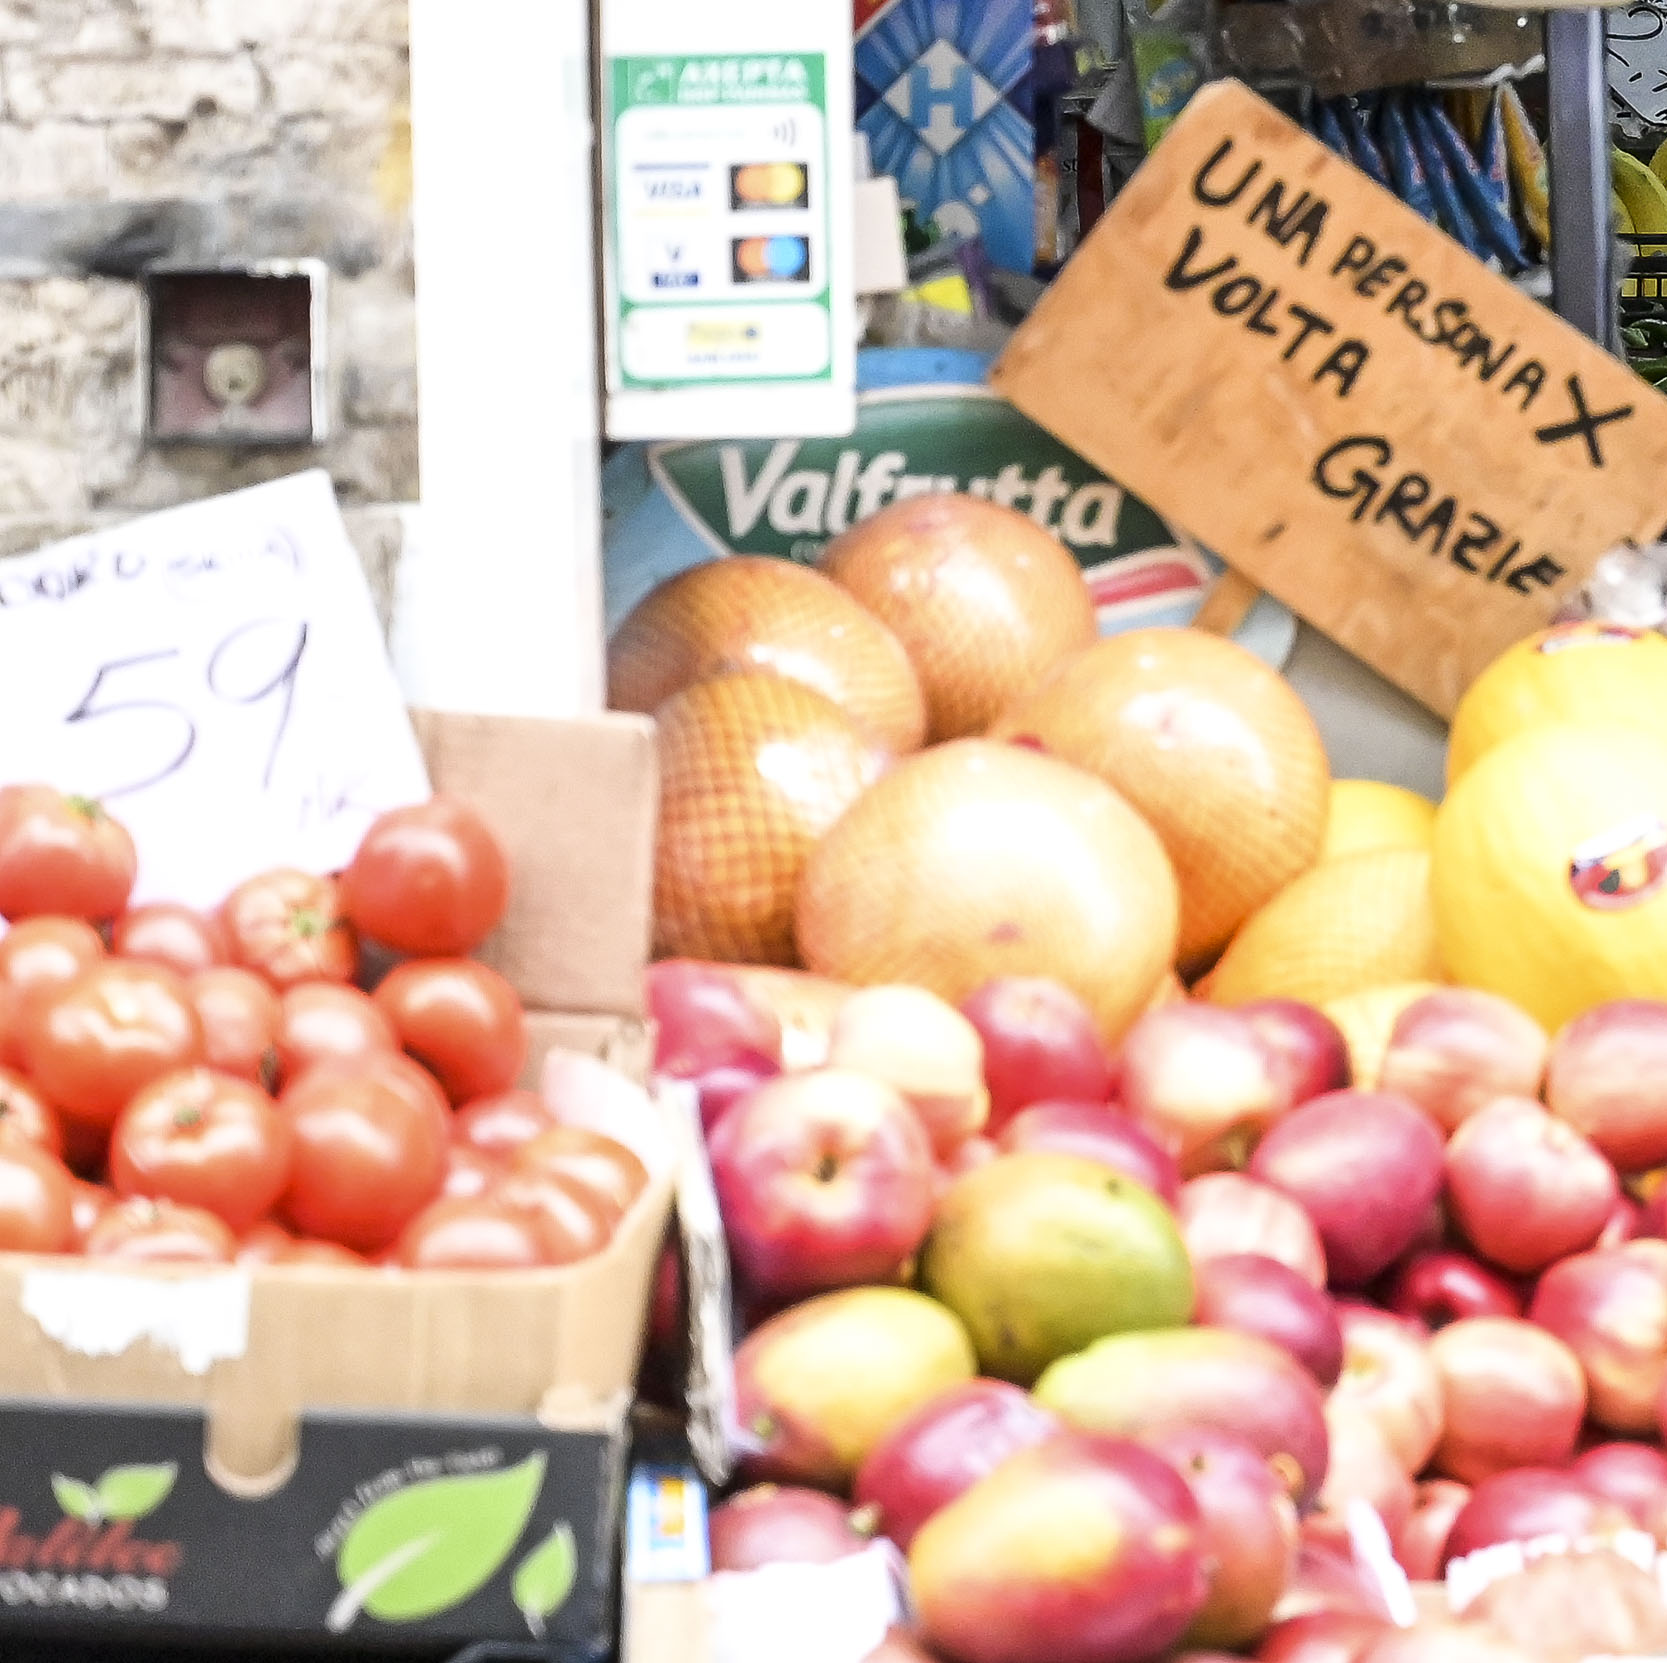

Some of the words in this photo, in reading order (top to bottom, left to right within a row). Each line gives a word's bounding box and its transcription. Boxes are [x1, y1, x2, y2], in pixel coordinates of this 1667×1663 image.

[1161, 226, 1370, 402] VOLTA
[1190, 139, 1318, 270] UNA
[1328, 231, 1550, 415] PERSONA
[1532, 373, 1637, 468] X
[1312, 432, 1565, 598] GRAZIE
